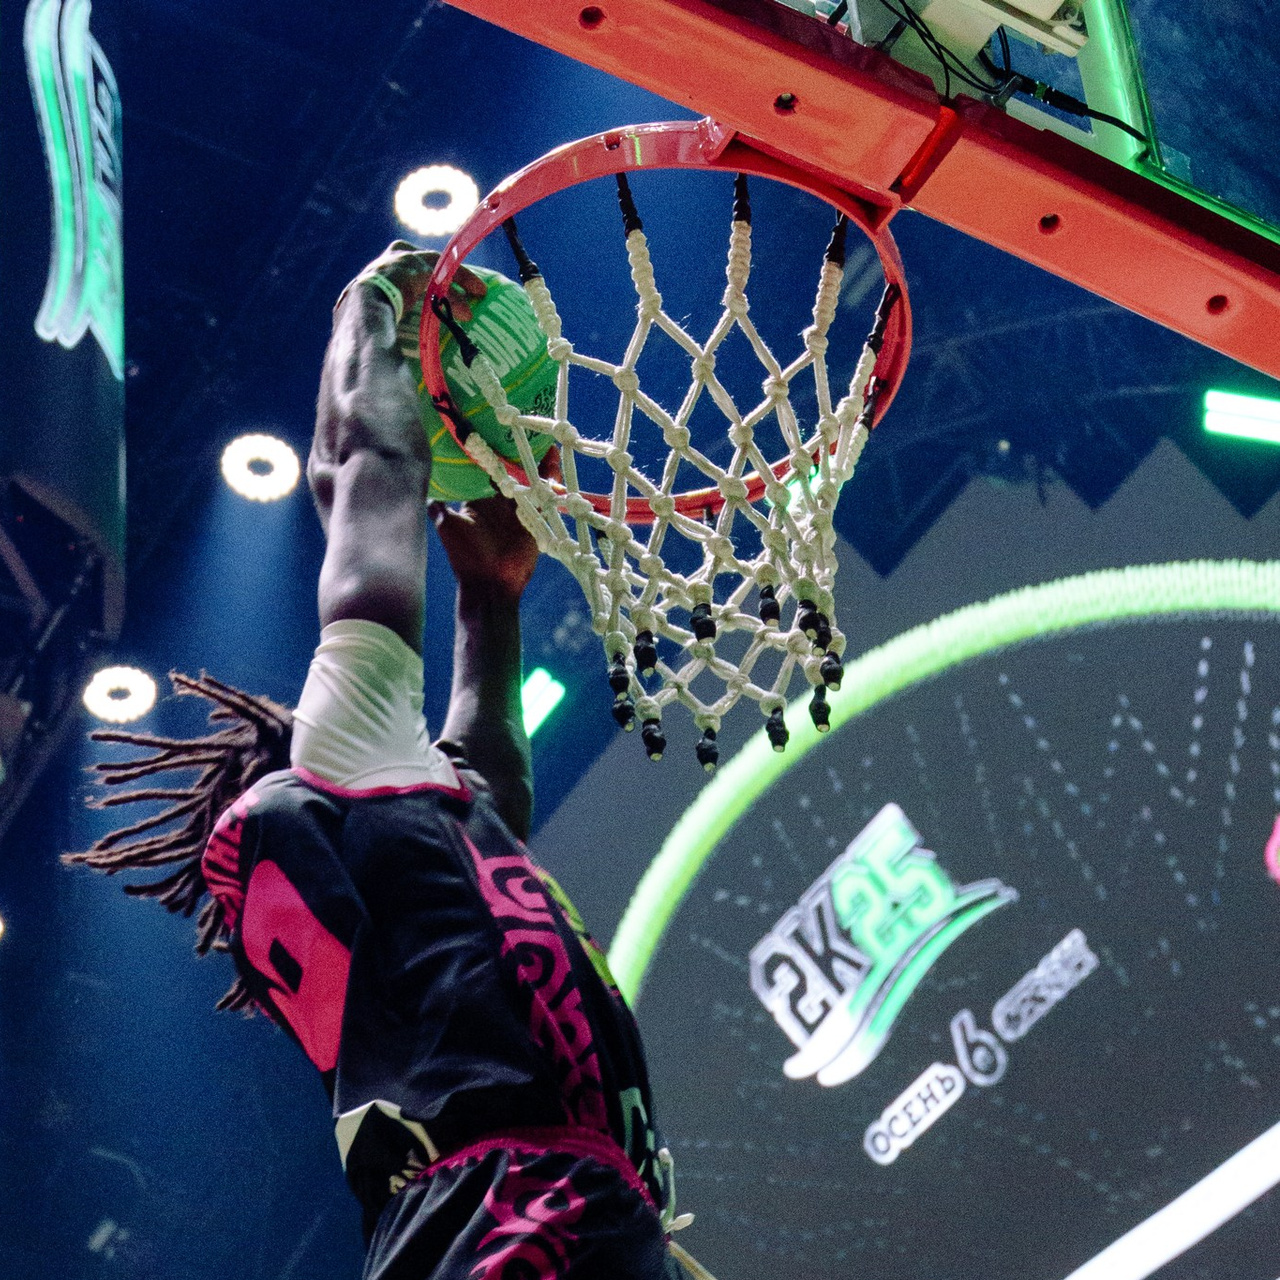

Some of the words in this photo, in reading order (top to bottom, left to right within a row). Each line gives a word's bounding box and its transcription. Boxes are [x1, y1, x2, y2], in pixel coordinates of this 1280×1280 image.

[750, 803, 958, 1048] 2K25
[867, 1064, 963, 1160] ОСЕНЬ
[950, 1007, 1008, 1086] 6
